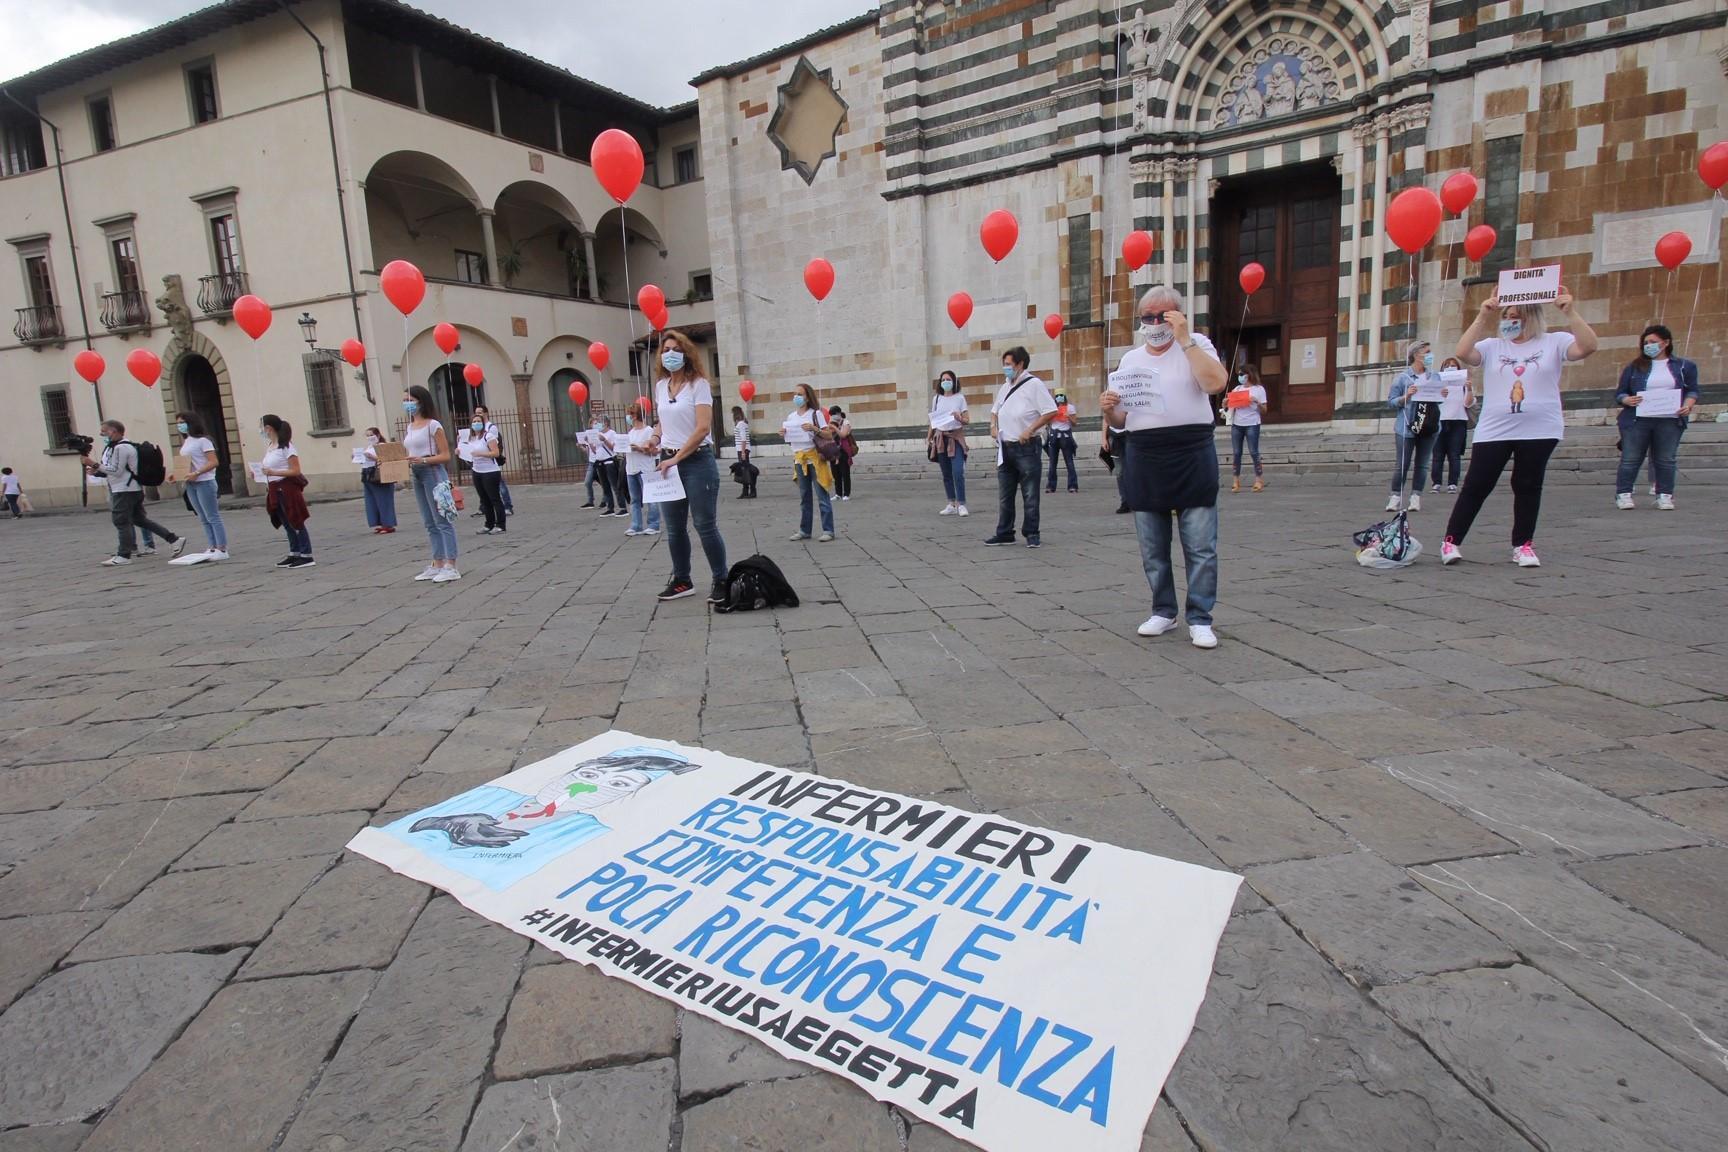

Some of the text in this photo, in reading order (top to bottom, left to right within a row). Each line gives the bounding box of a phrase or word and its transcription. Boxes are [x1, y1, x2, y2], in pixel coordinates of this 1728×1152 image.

[1498, 290, 1557, 303] PROFESSIONALE
[730, 770, 1092, 885] INFERMIERI
[624, 829, 1017, 985] COMPETENZA E
[519, 907, 978, 1130] #INFERMIERIUSAEGETTA
[555, 861, 1116, 1128] POCA RICONOSCENZA
